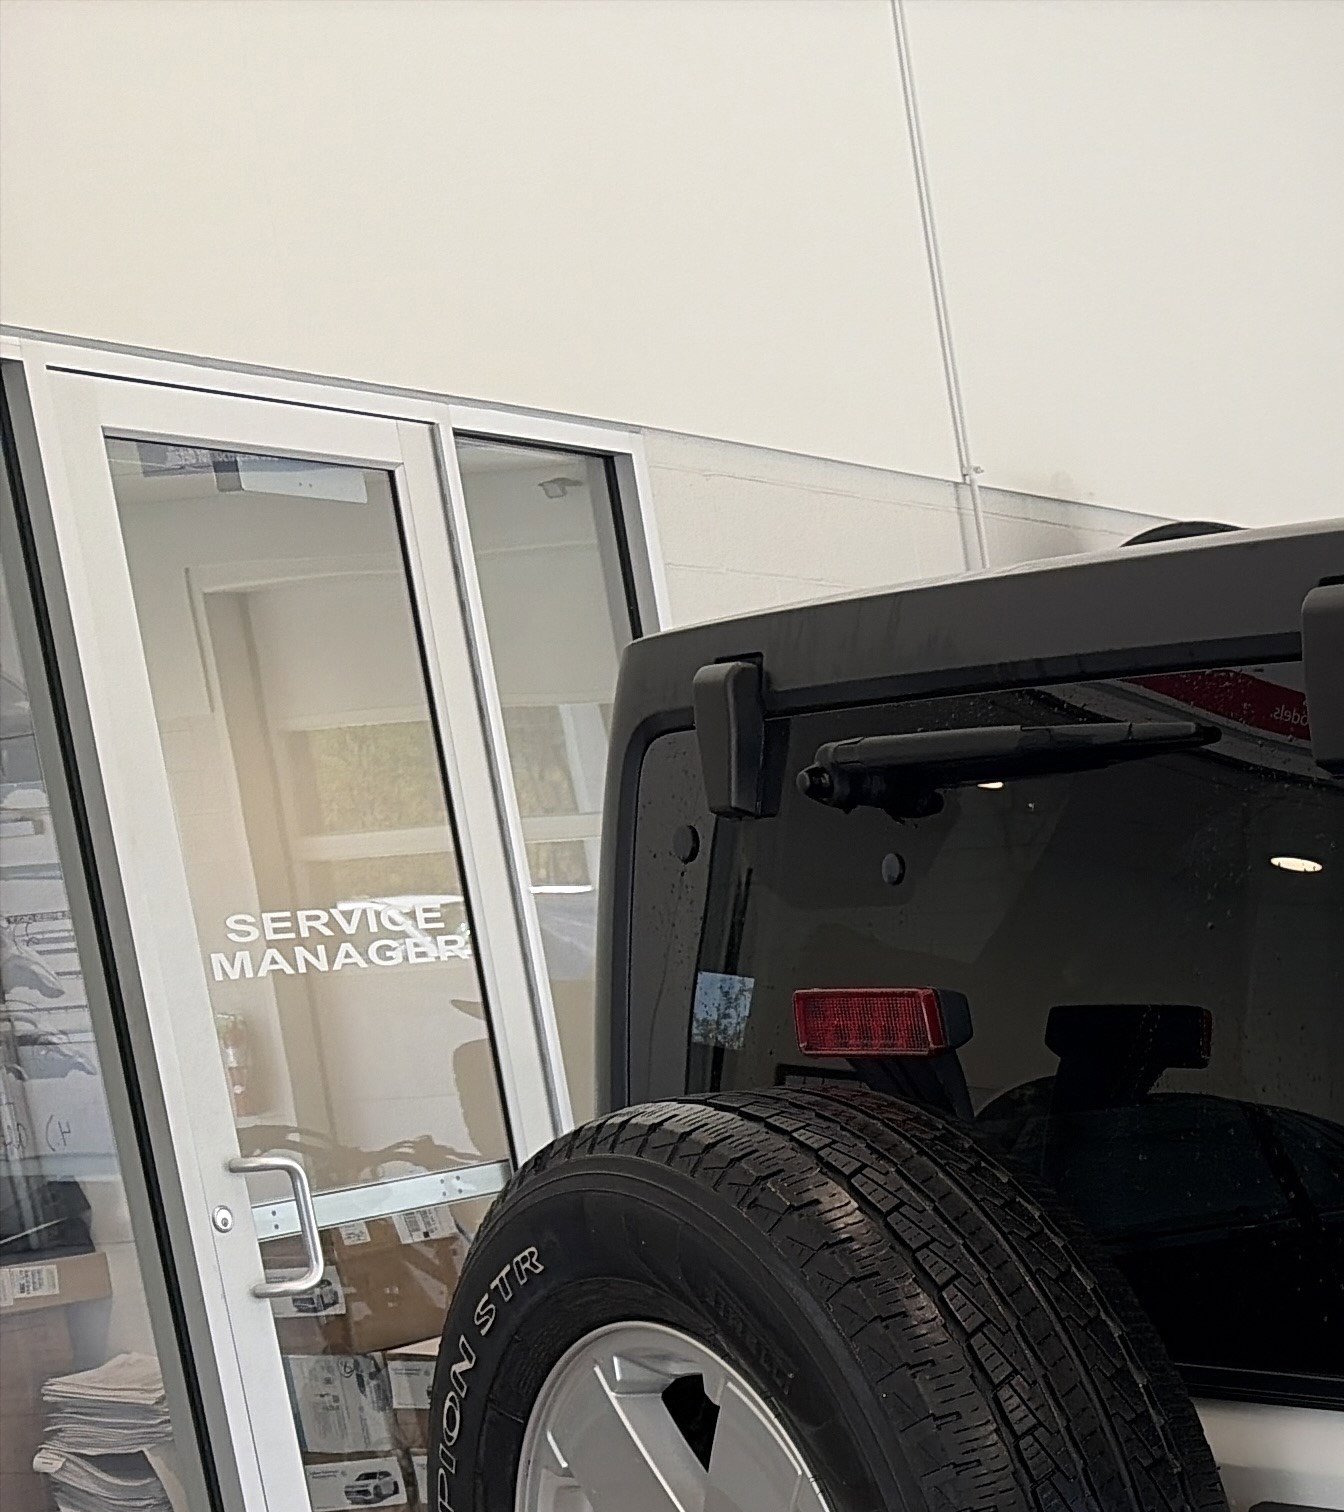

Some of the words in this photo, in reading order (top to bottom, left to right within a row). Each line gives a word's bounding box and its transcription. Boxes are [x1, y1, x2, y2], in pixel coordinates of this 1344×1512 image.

[225, 902, 446, 943] SERVICE
[209, 934, 472, 982] MANAGER
[474, 1245, 545, 1336] STR
